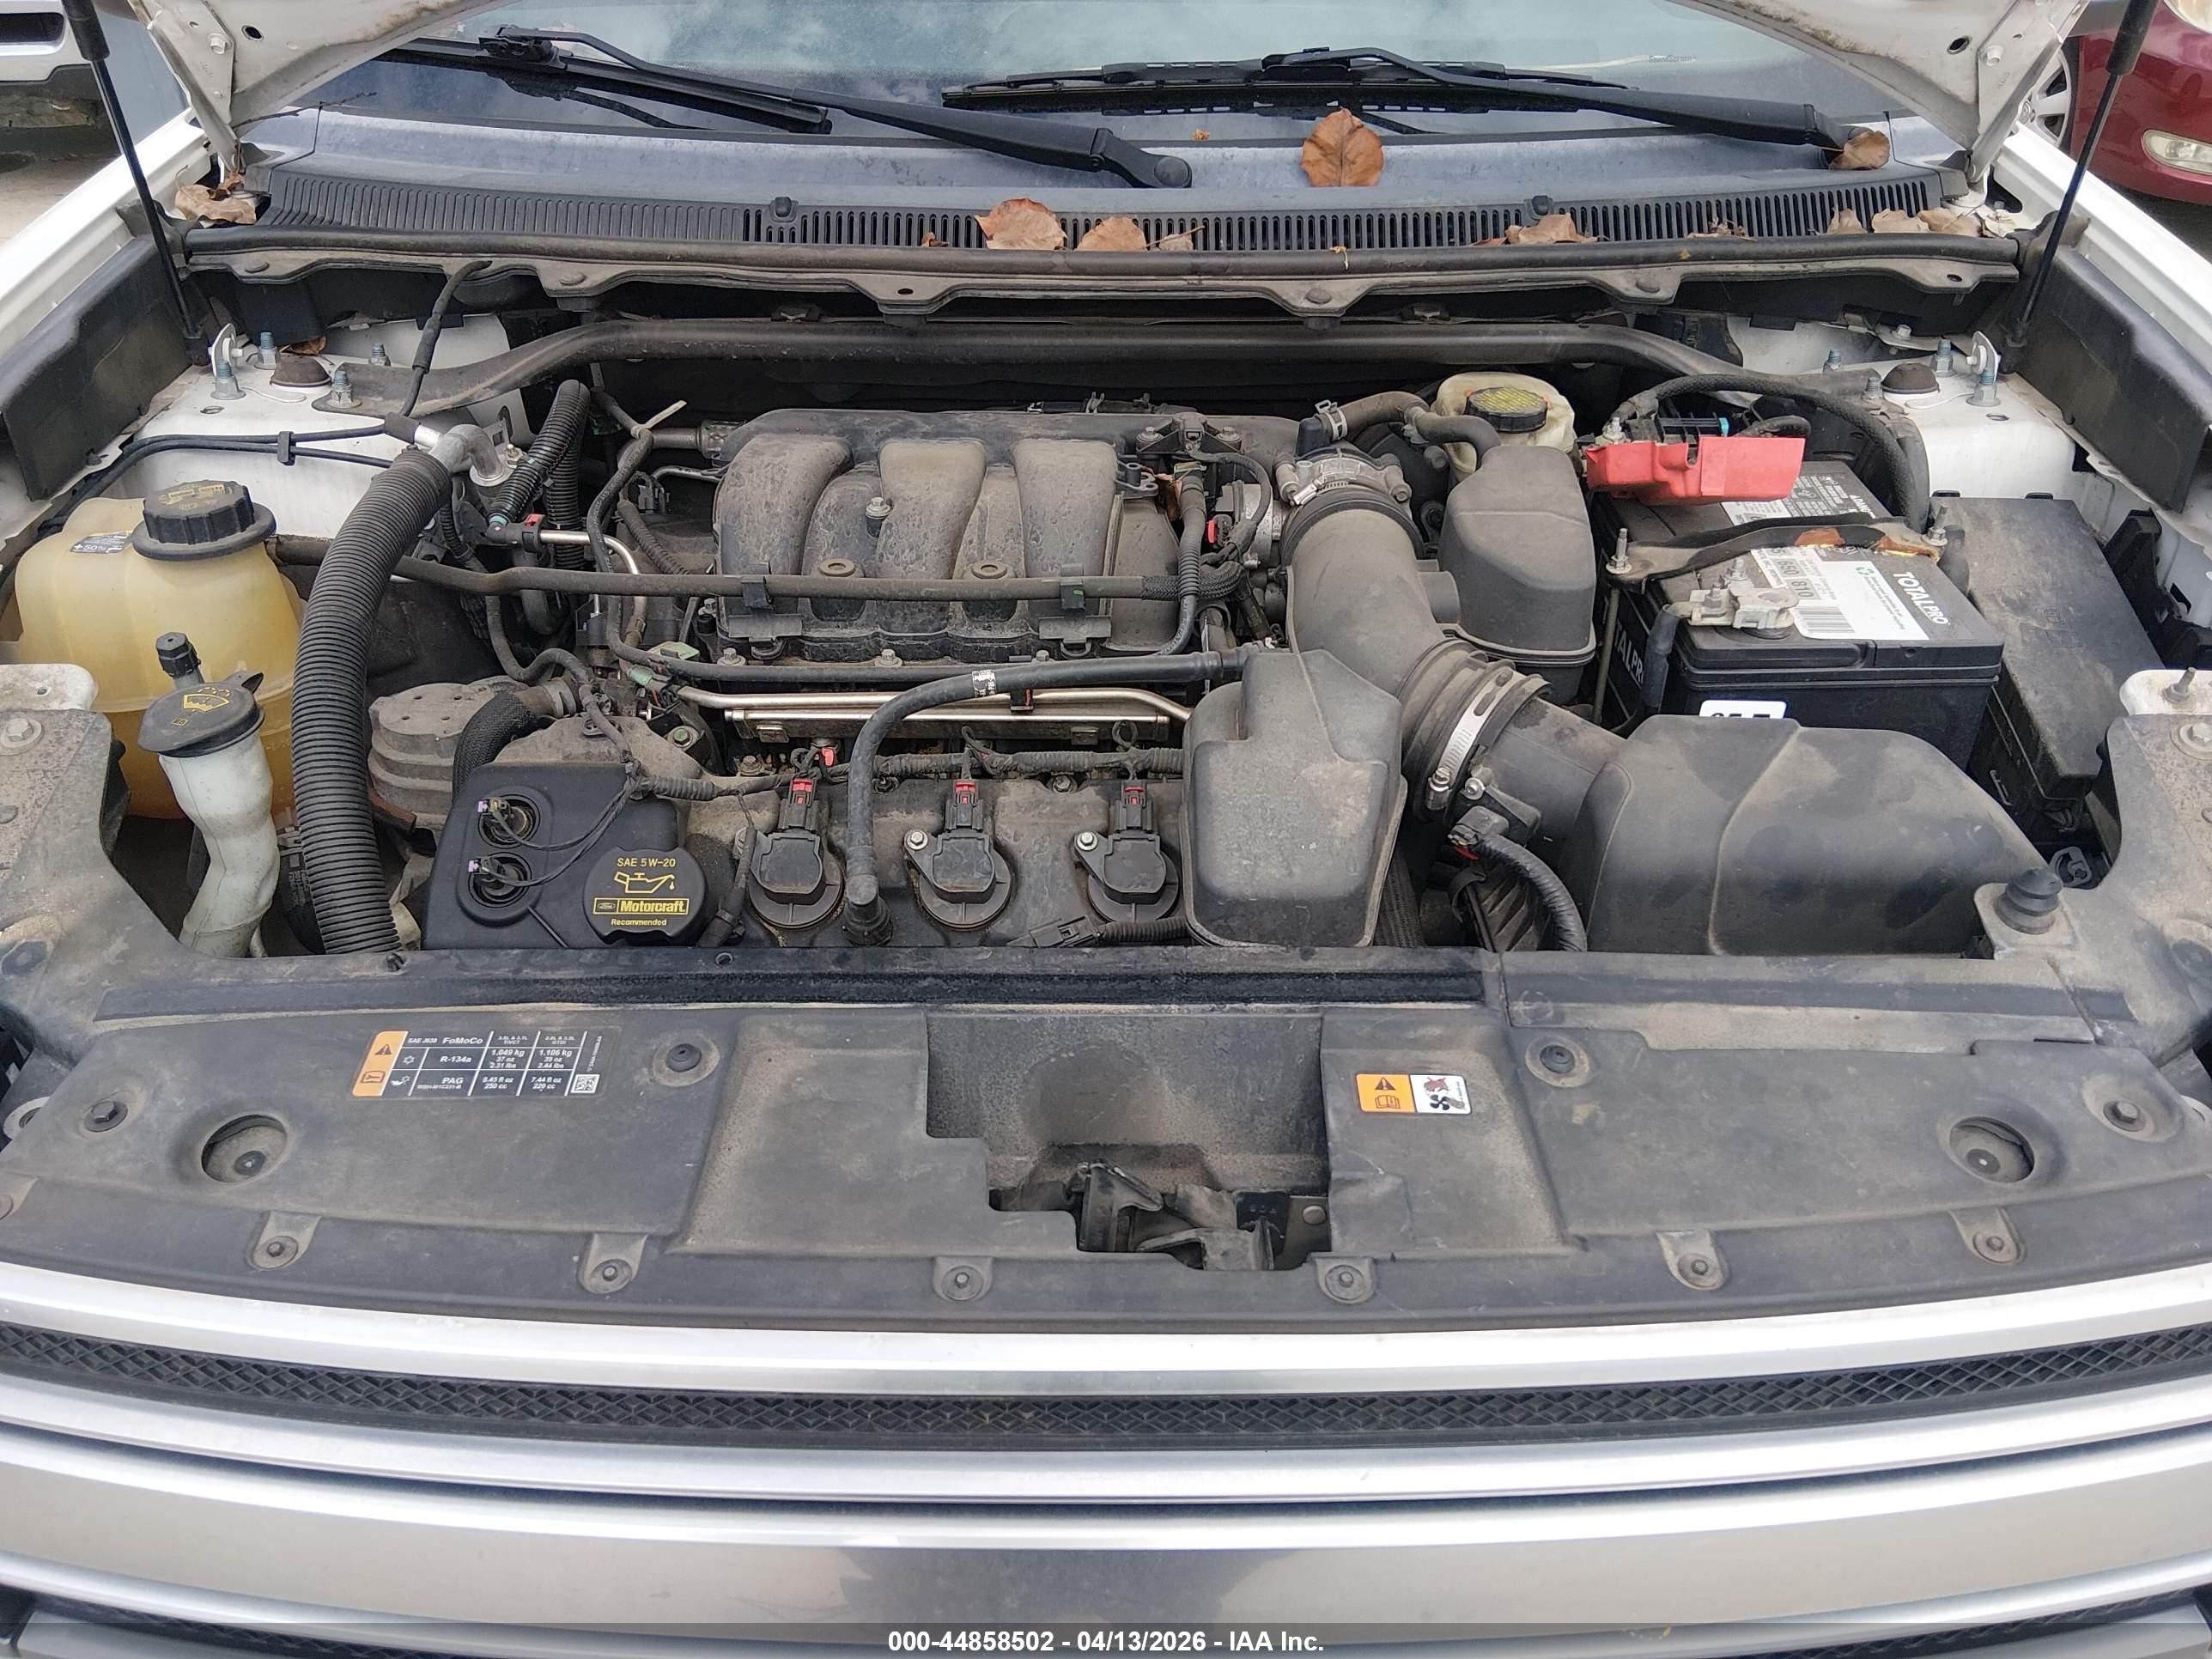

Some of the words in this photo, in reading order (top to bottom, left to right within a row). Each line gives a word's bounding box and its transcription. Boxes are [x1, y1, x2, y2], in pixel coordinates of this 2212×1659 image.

[1778, 561, 1800, 575] 650
[1791, 580, 1814, 598] 810
[1893, 571, 1949, 625] TOTALPRO
[1613, 618, 1644, 684] TALPR
[617, 858, 637, 867] SAE
[640, 858, 677, 867] 5W-20
[620, 900, 685, 913] Motorcraft
[514, 1048, 526, 1057] kg
